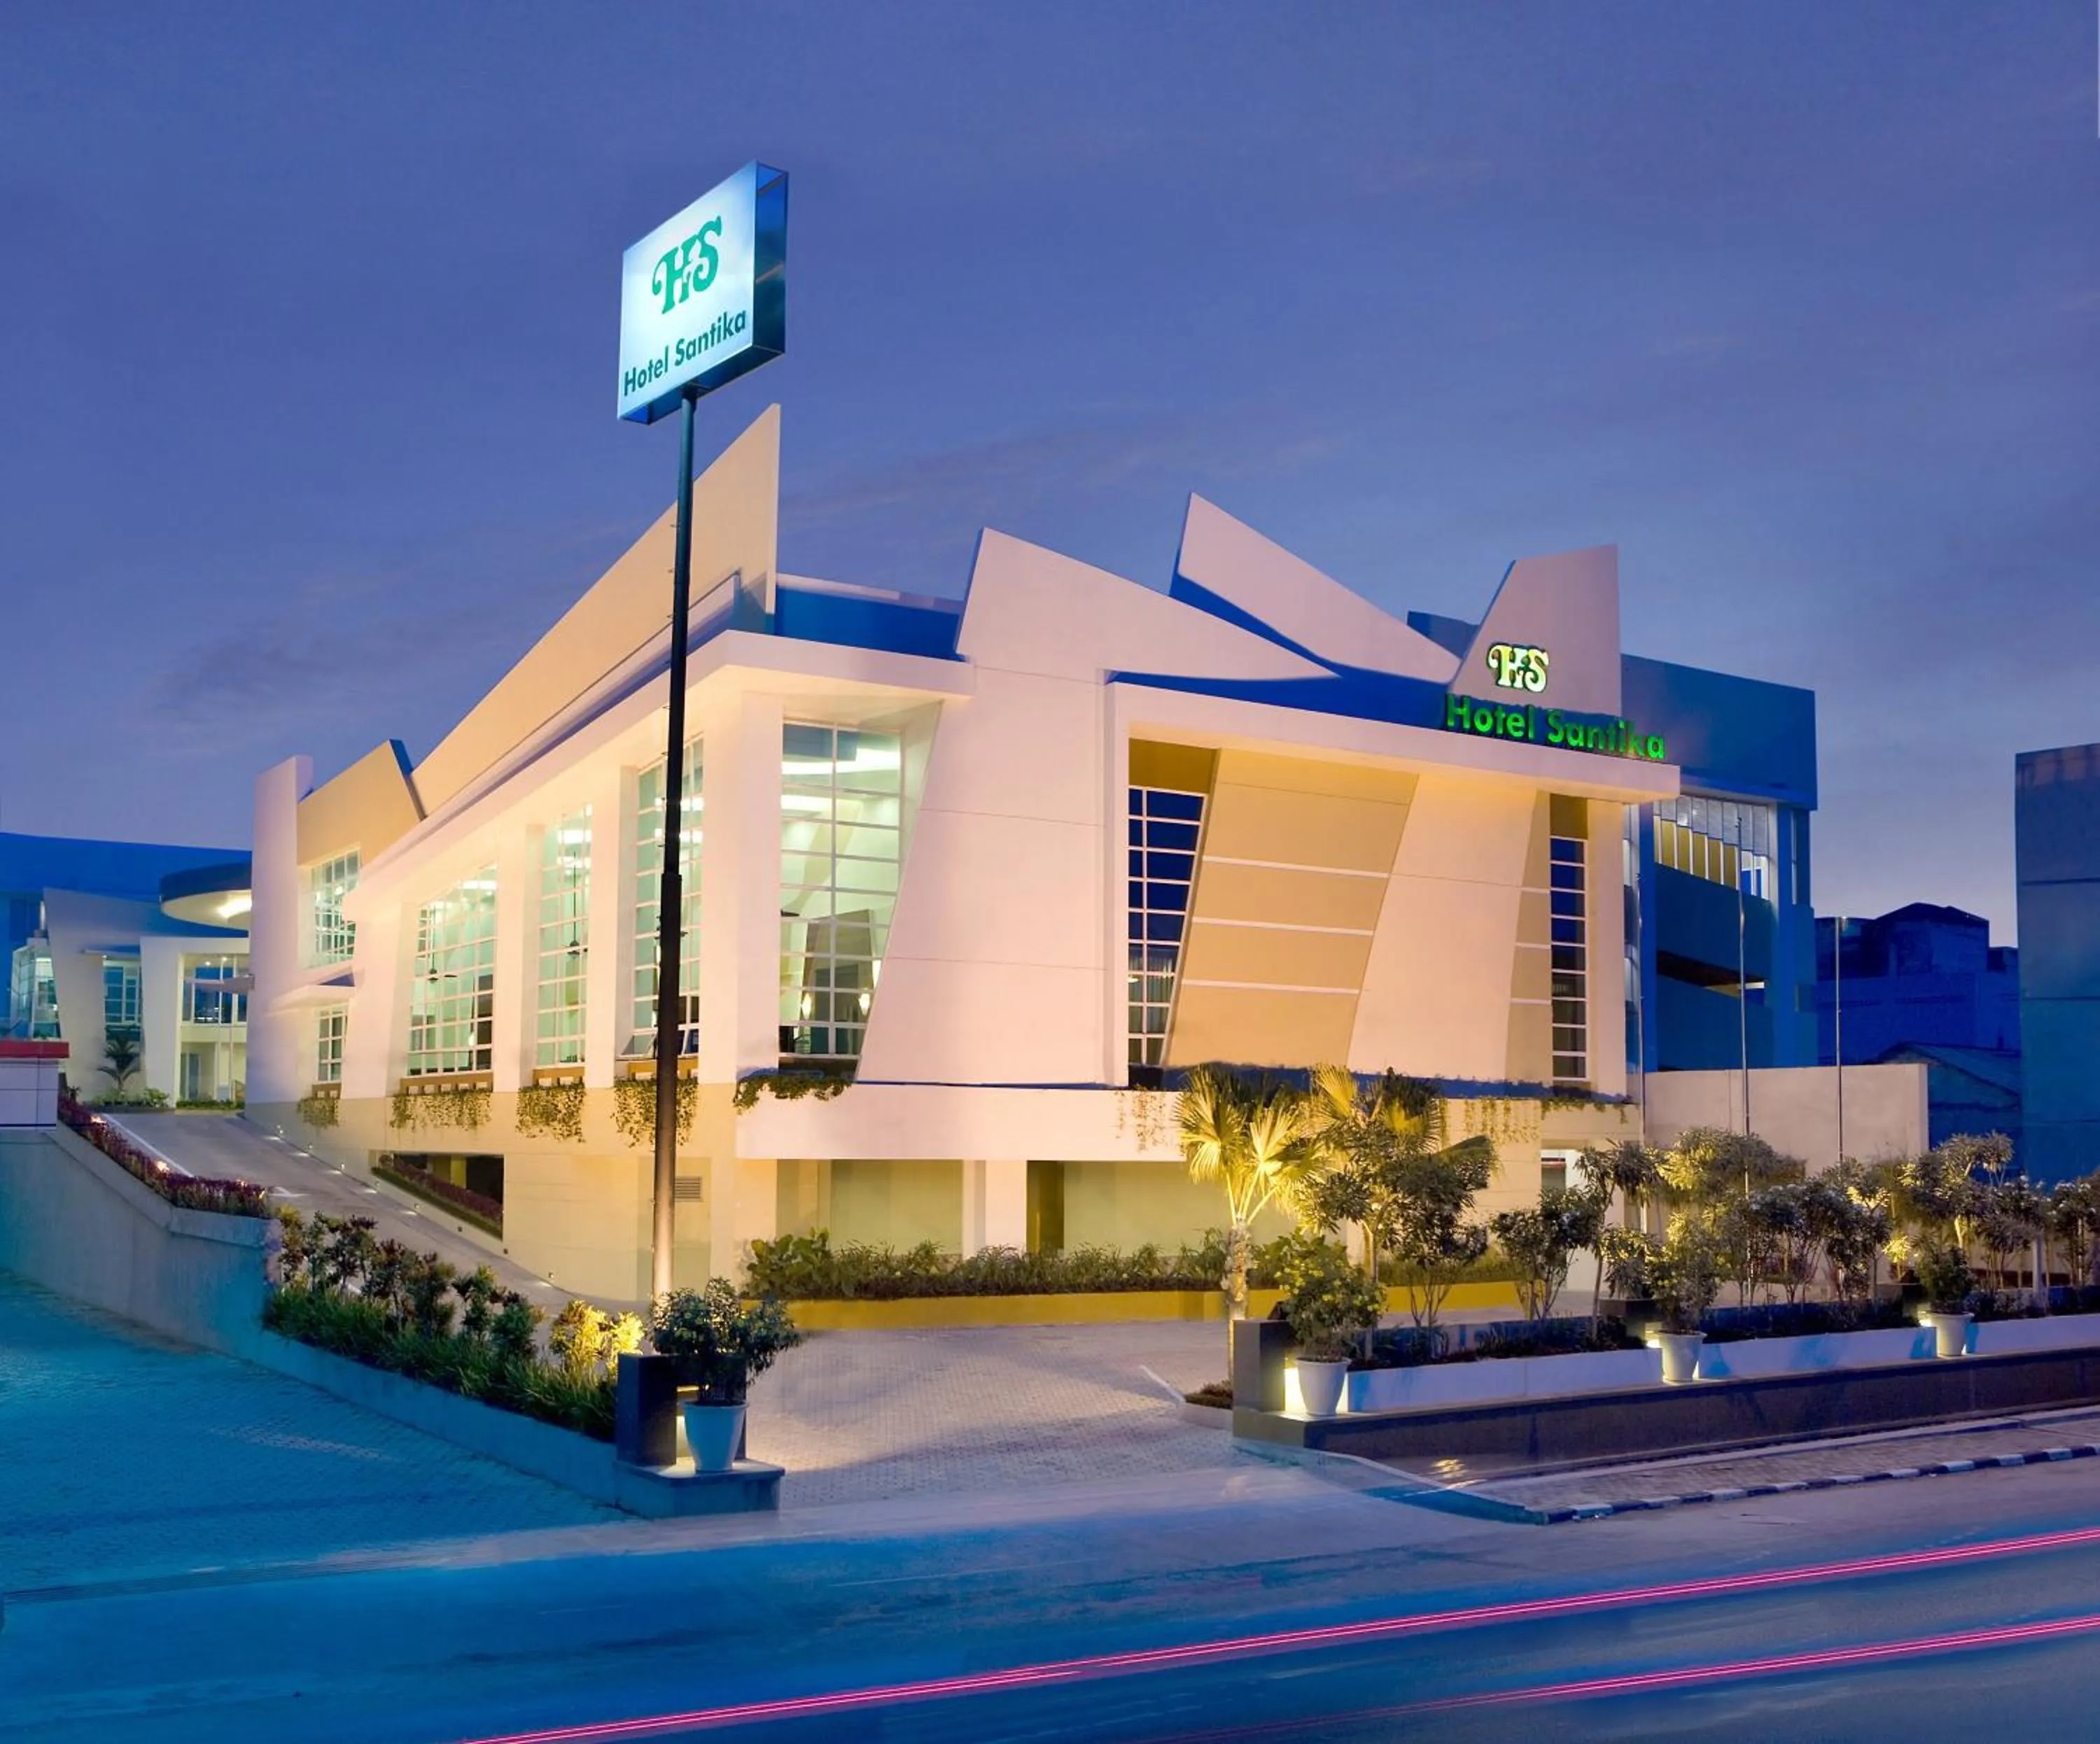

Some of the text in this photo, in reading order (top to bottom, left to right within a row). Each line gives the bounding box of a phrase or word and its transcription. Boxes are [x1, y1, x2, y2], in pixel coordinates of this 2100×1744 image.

[624, 310, 746, 396] Hotel Santika
[1446, 692, 1665, 759] Hotel Santika
